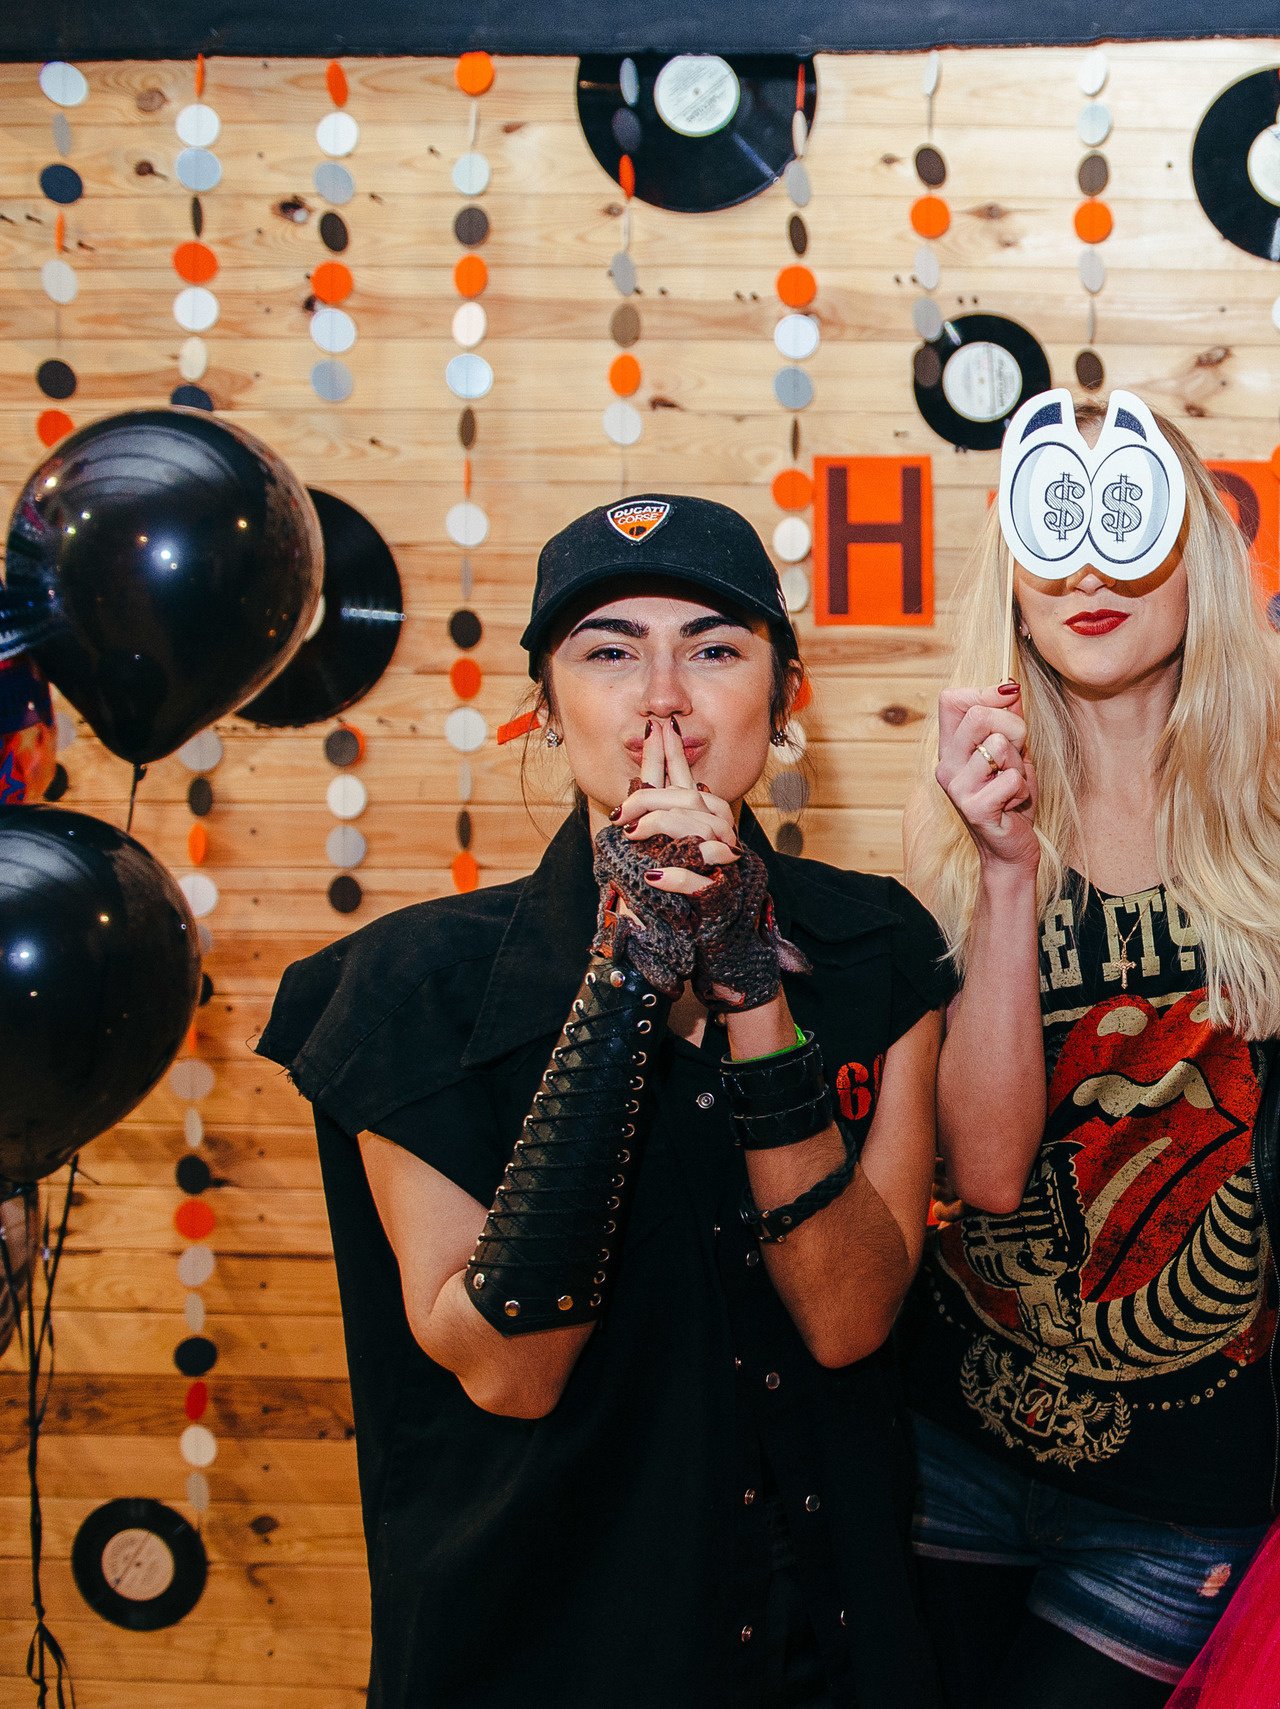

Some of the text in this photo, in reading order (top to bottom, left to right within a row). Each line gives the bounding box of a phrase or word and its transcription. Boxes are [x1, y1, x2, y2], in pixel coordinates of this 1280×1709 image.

[613, 505, 665, 519] DUCATI
[617, 512, 659, 525] CORSE
[1040, 898, 1083, 992] E
